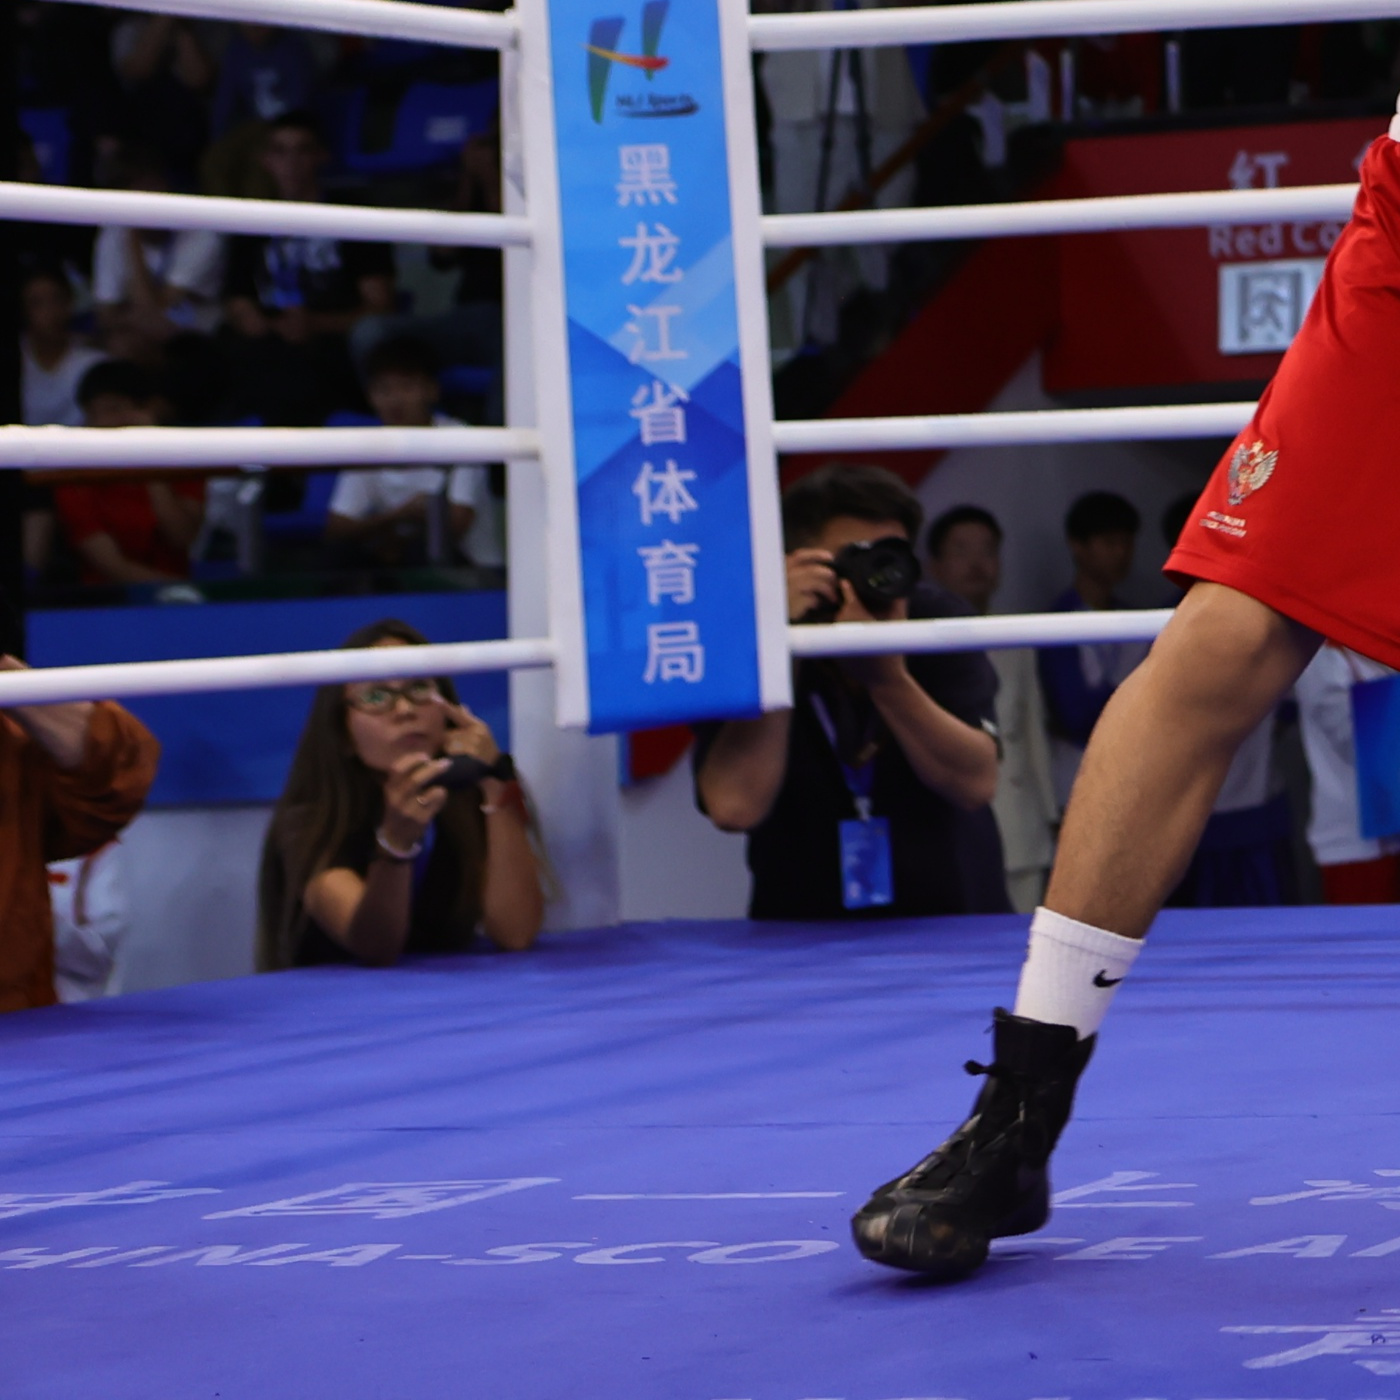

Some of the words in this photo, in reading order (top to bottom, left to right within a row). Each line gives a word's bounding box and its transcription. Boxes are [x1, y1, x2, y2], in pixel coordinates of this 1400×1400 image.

[1208, 223, 1283, 258] Red
[615, 143, 705, 686] 黑龙江省体育局
